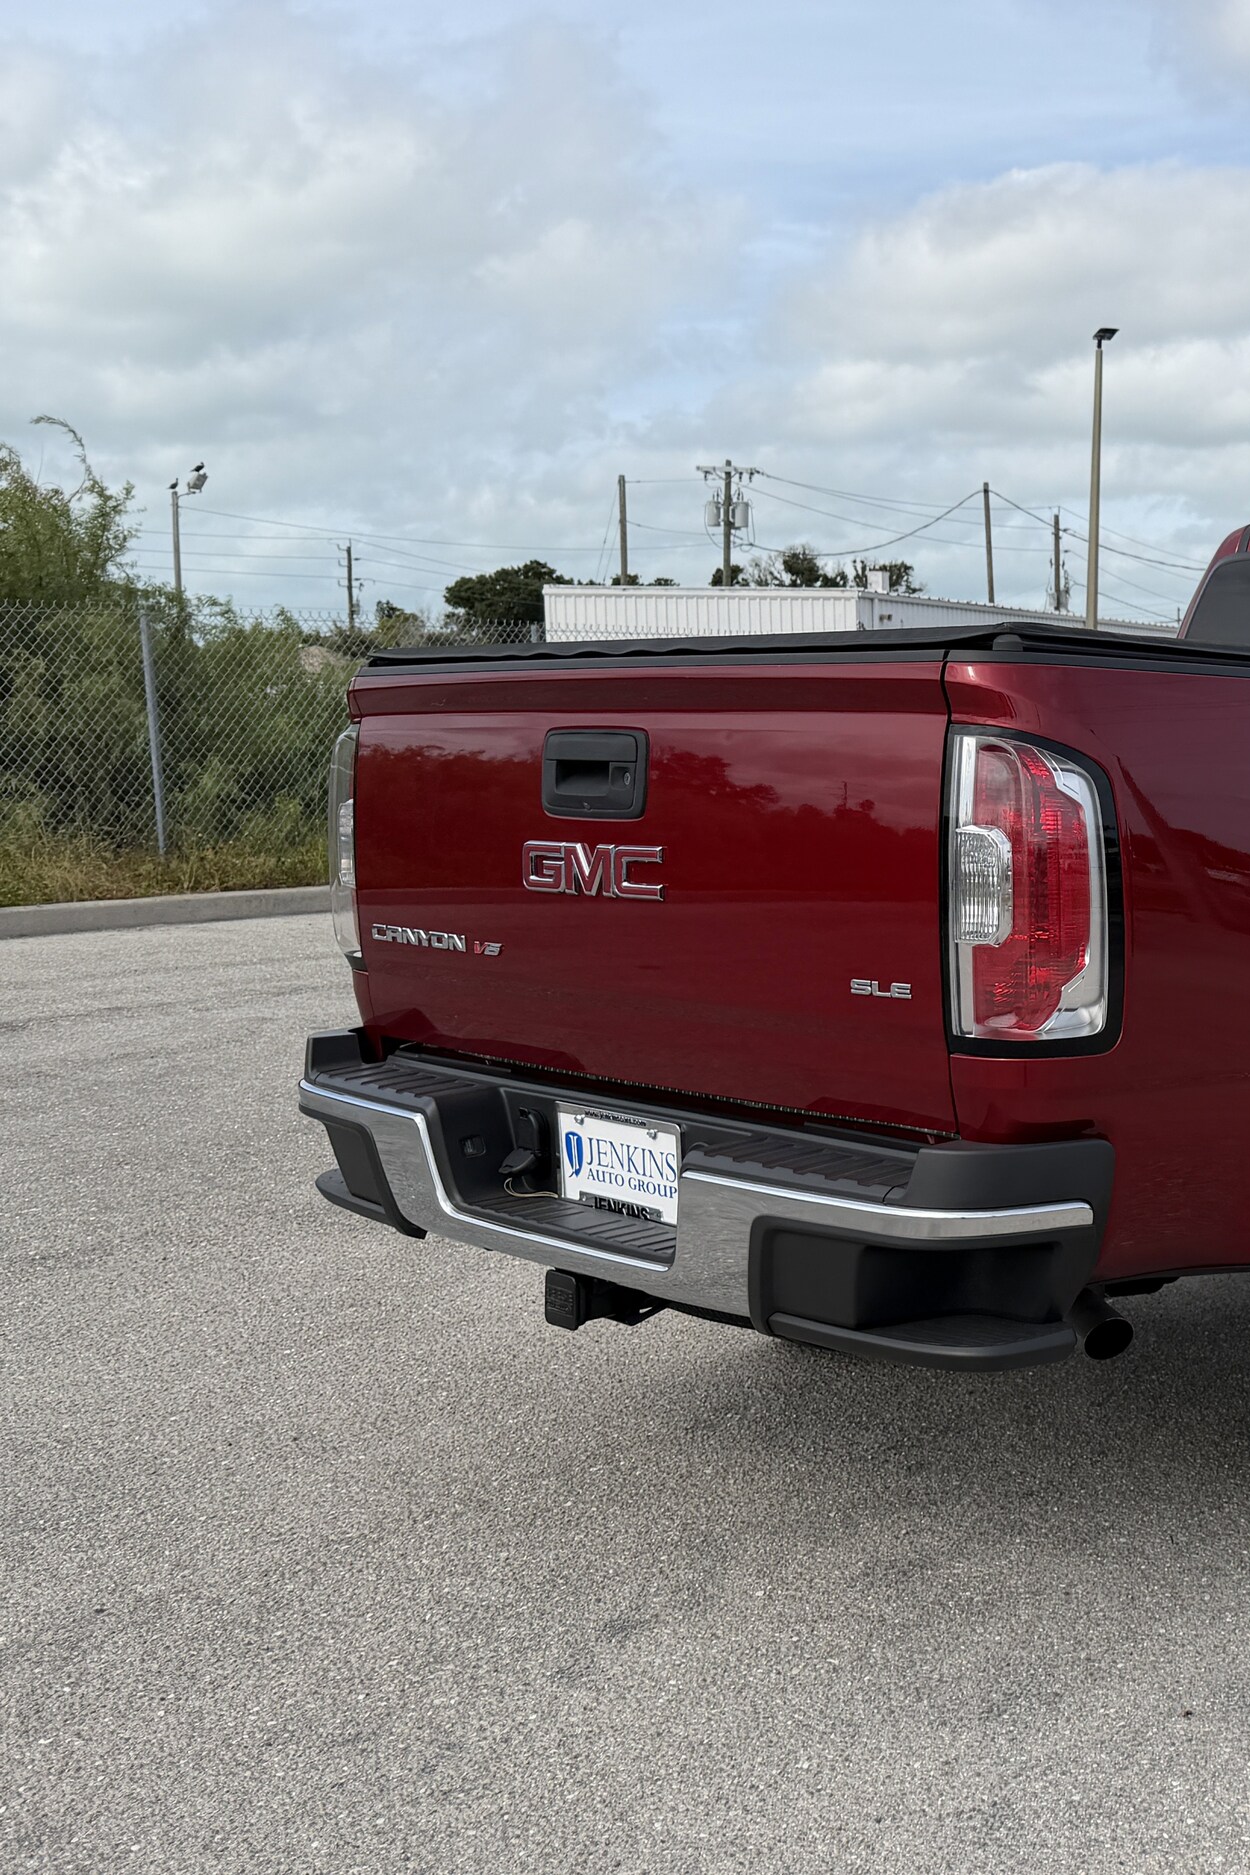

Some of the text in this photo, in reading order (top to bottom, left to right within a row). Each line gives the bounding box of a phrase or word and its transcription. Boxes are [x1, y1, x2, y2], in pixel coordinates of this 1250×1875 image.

[522, 839, 665, 902] GMC
[371, 923, 503, 956] CANYON V6
[850, 978, 912, 1000] SLE
[586, 1136, 677, 1183] JENKINS
[586, 1168, 678, 1199] AUTO GROUP
